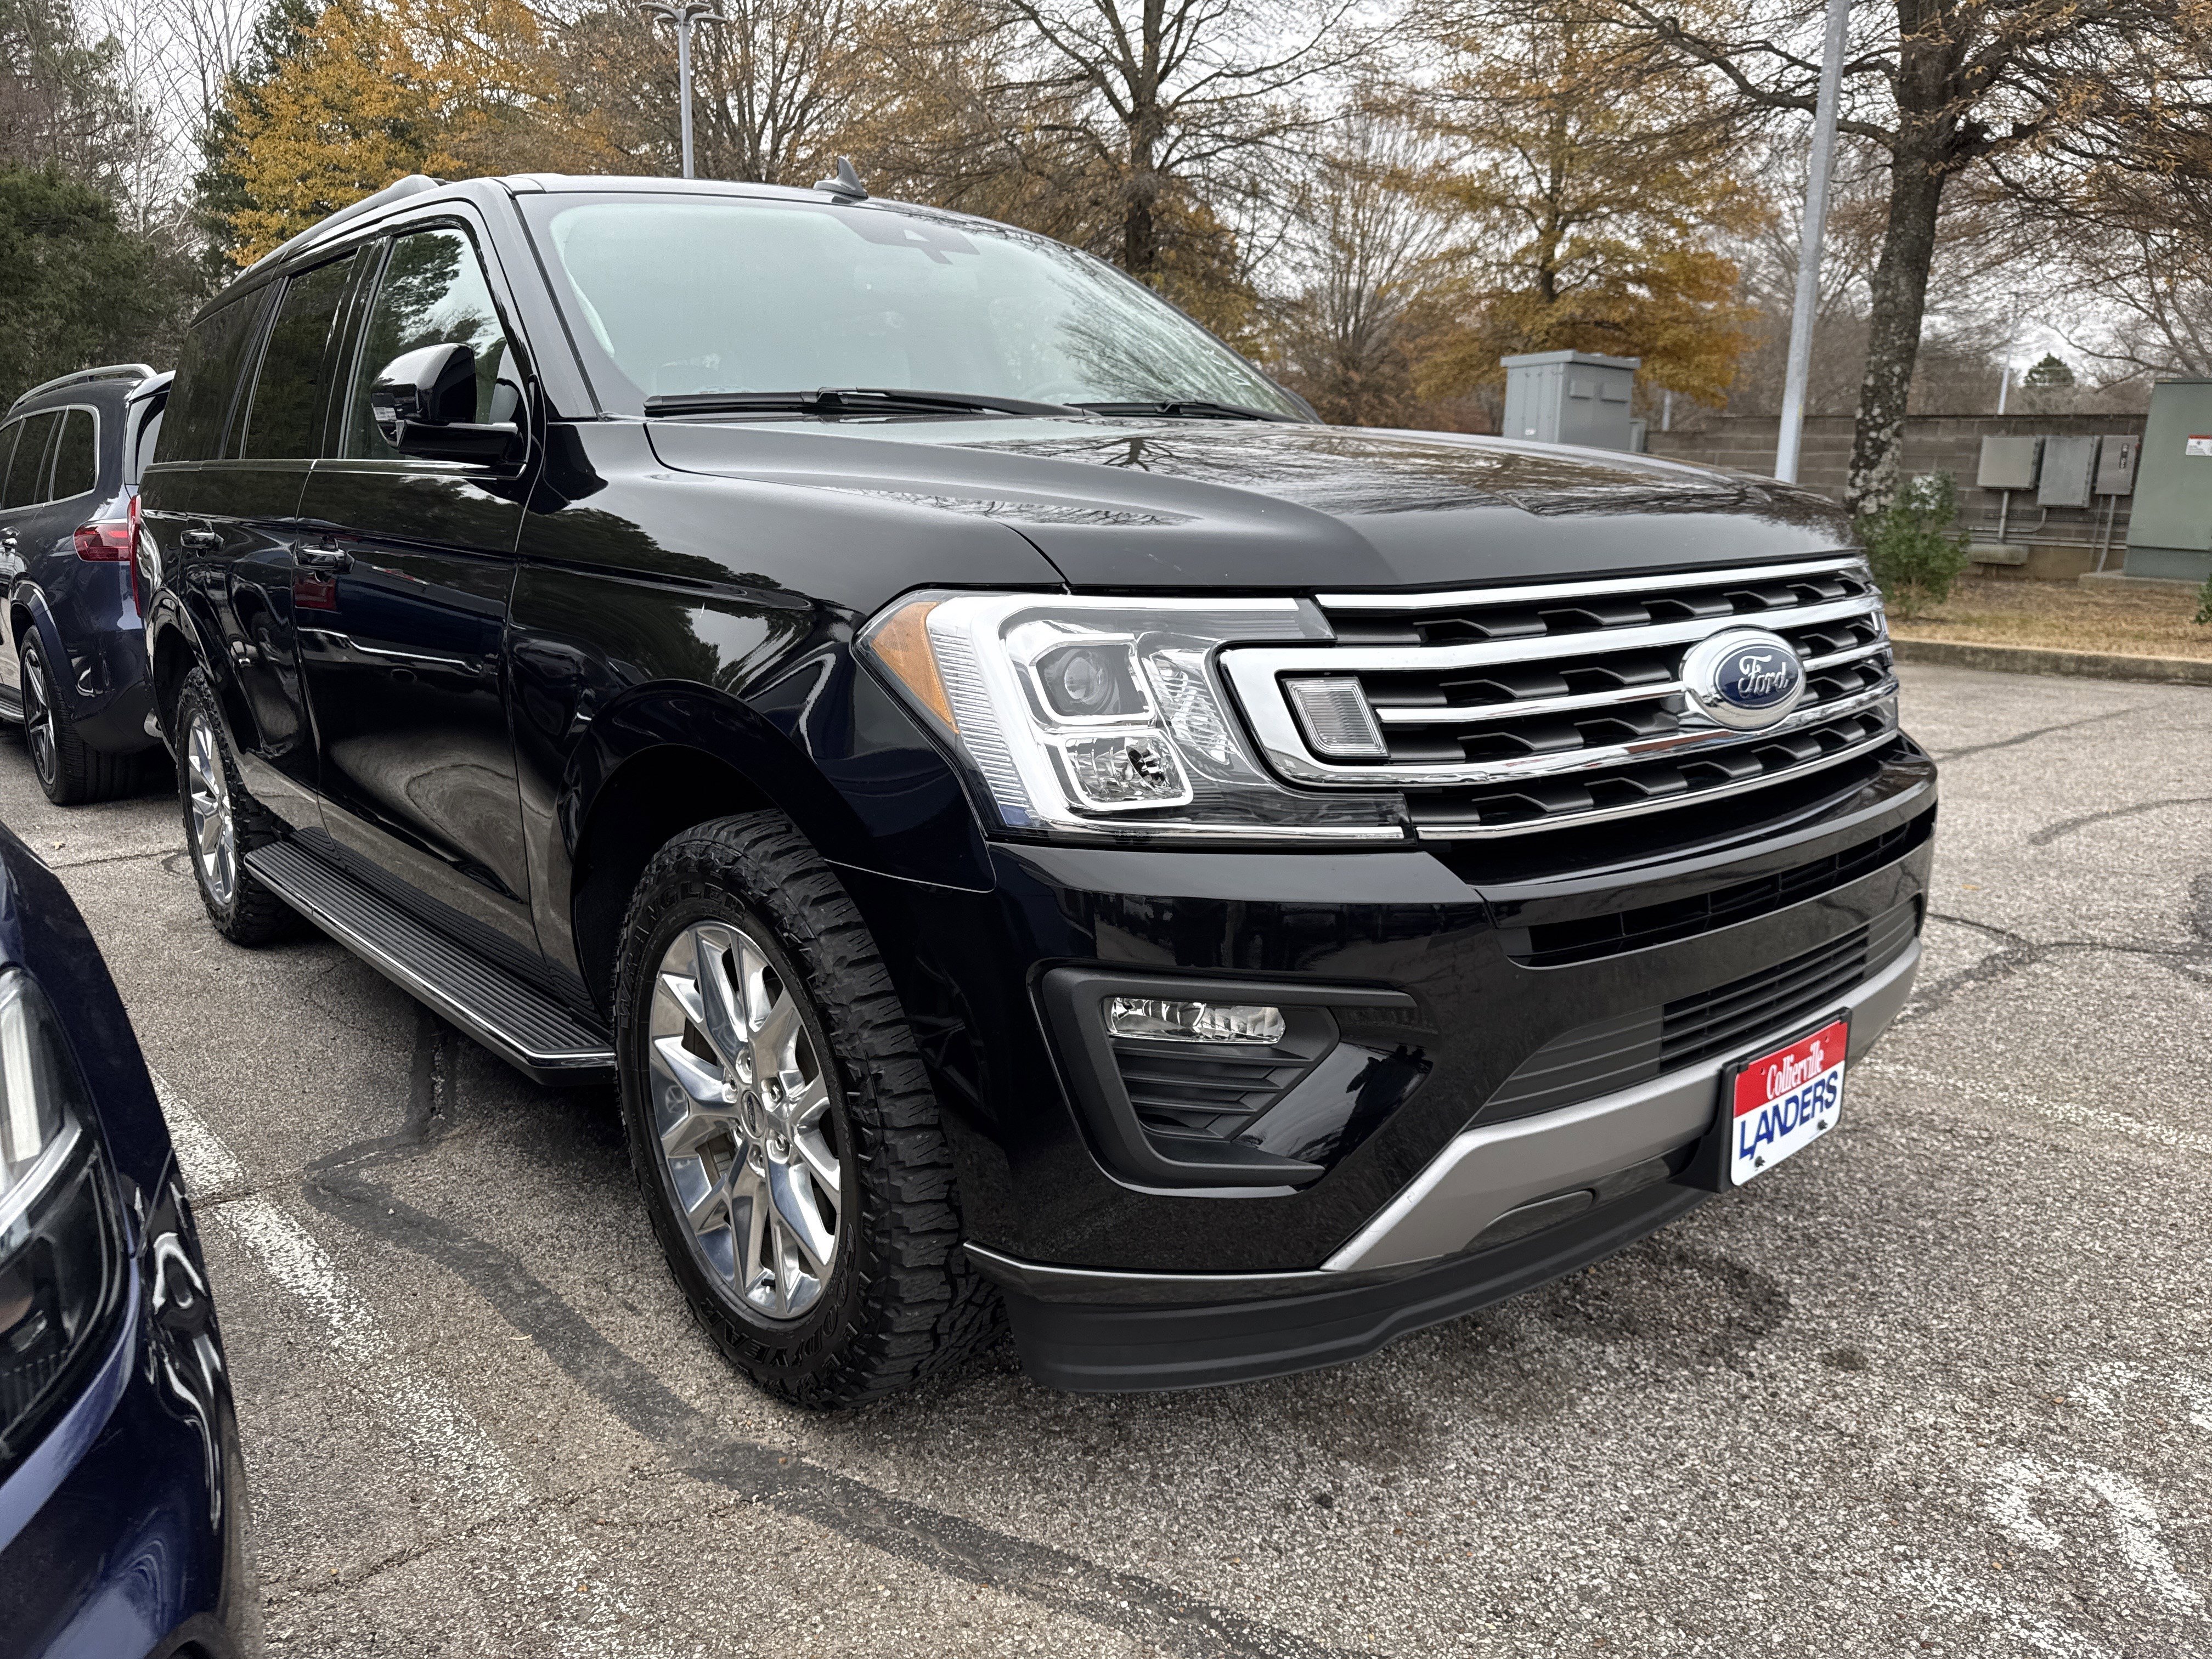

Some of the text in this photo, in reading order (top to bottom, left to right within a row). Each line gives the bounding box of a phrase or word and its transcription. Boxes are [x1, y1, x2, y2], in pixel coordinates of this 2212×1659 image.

[1739, 655, 1789, 698] Ford
[619, 881, 747, 1028] WRANGLER
[1767, 1040, 1824, 1100] Collierville
[1739, 1071, 1838, 1160] LANDERS
[700, 1223, 856, 1368] GOODYEAR
